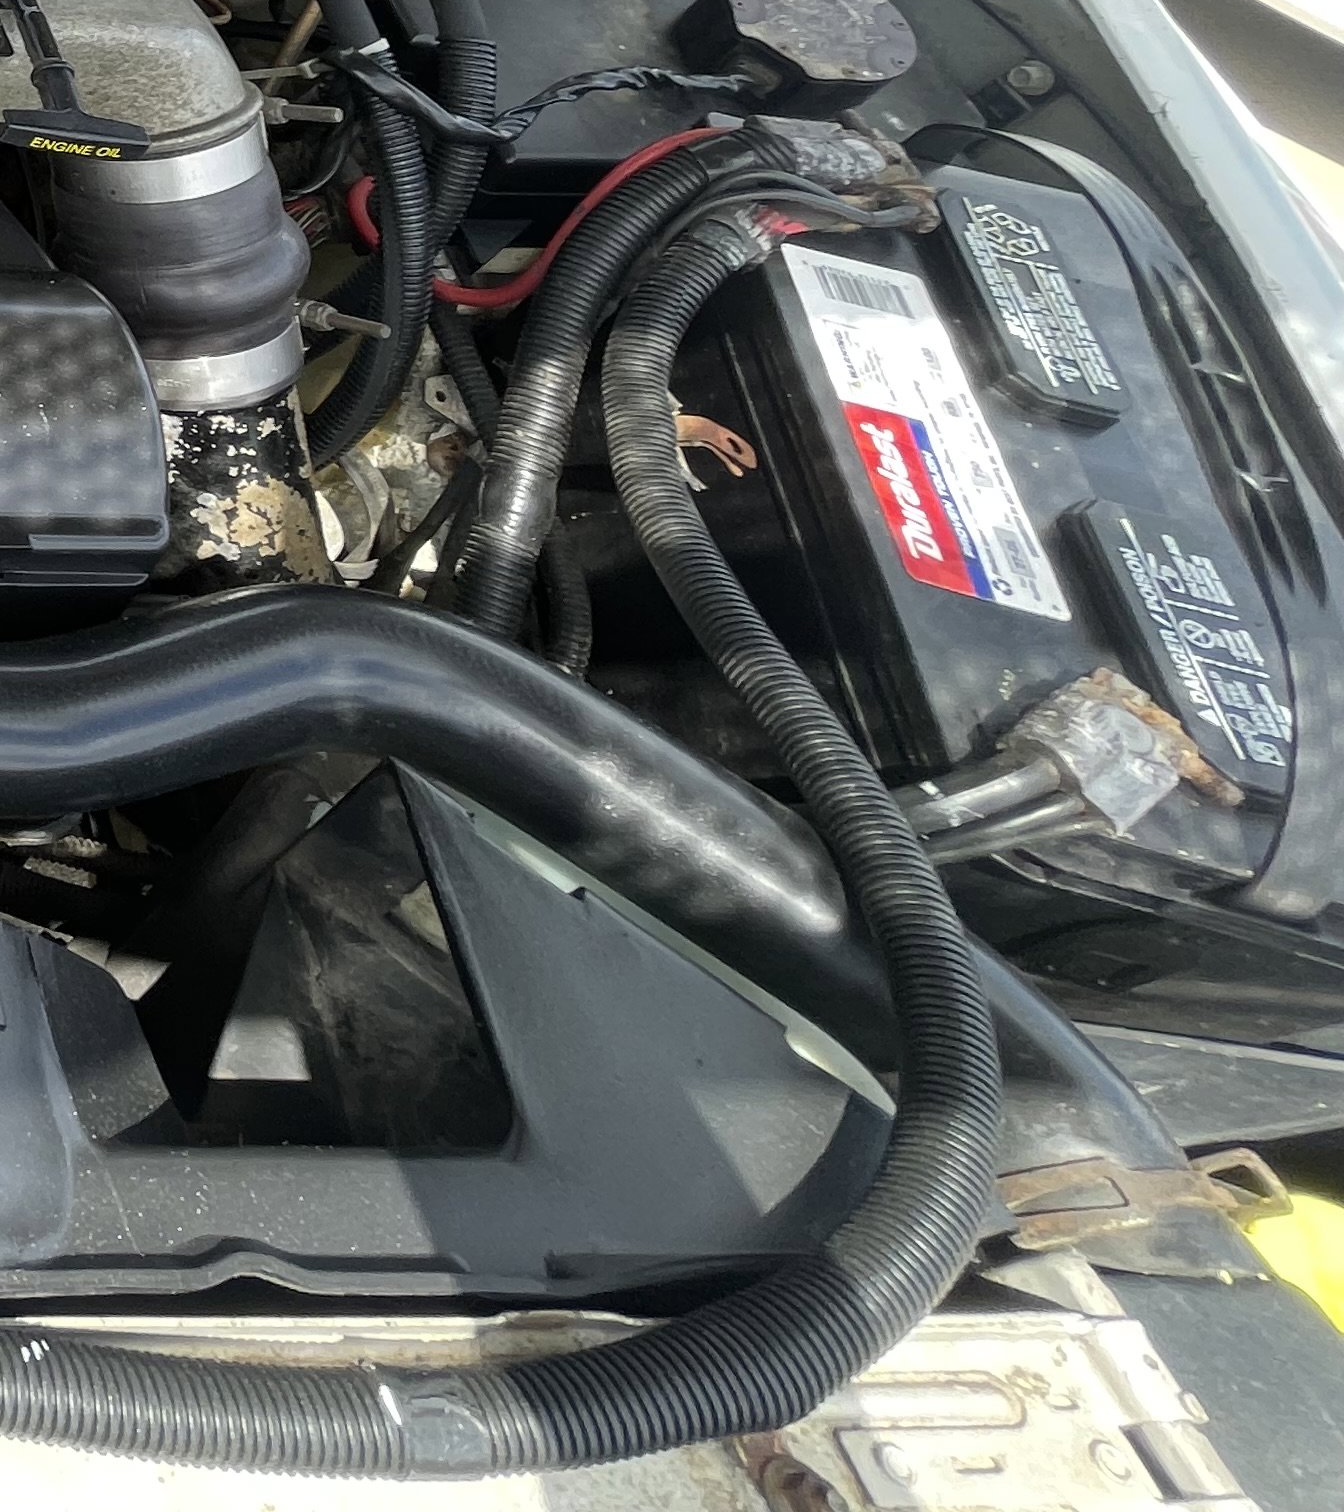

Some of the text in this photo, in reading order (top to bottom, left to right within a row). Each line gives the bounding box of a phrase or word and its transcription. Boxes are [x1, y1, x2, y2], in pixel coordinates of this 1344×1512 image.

[29, 136, 122, 159] ENGINE OIL
[859, 421, 945, 562] Duralast
